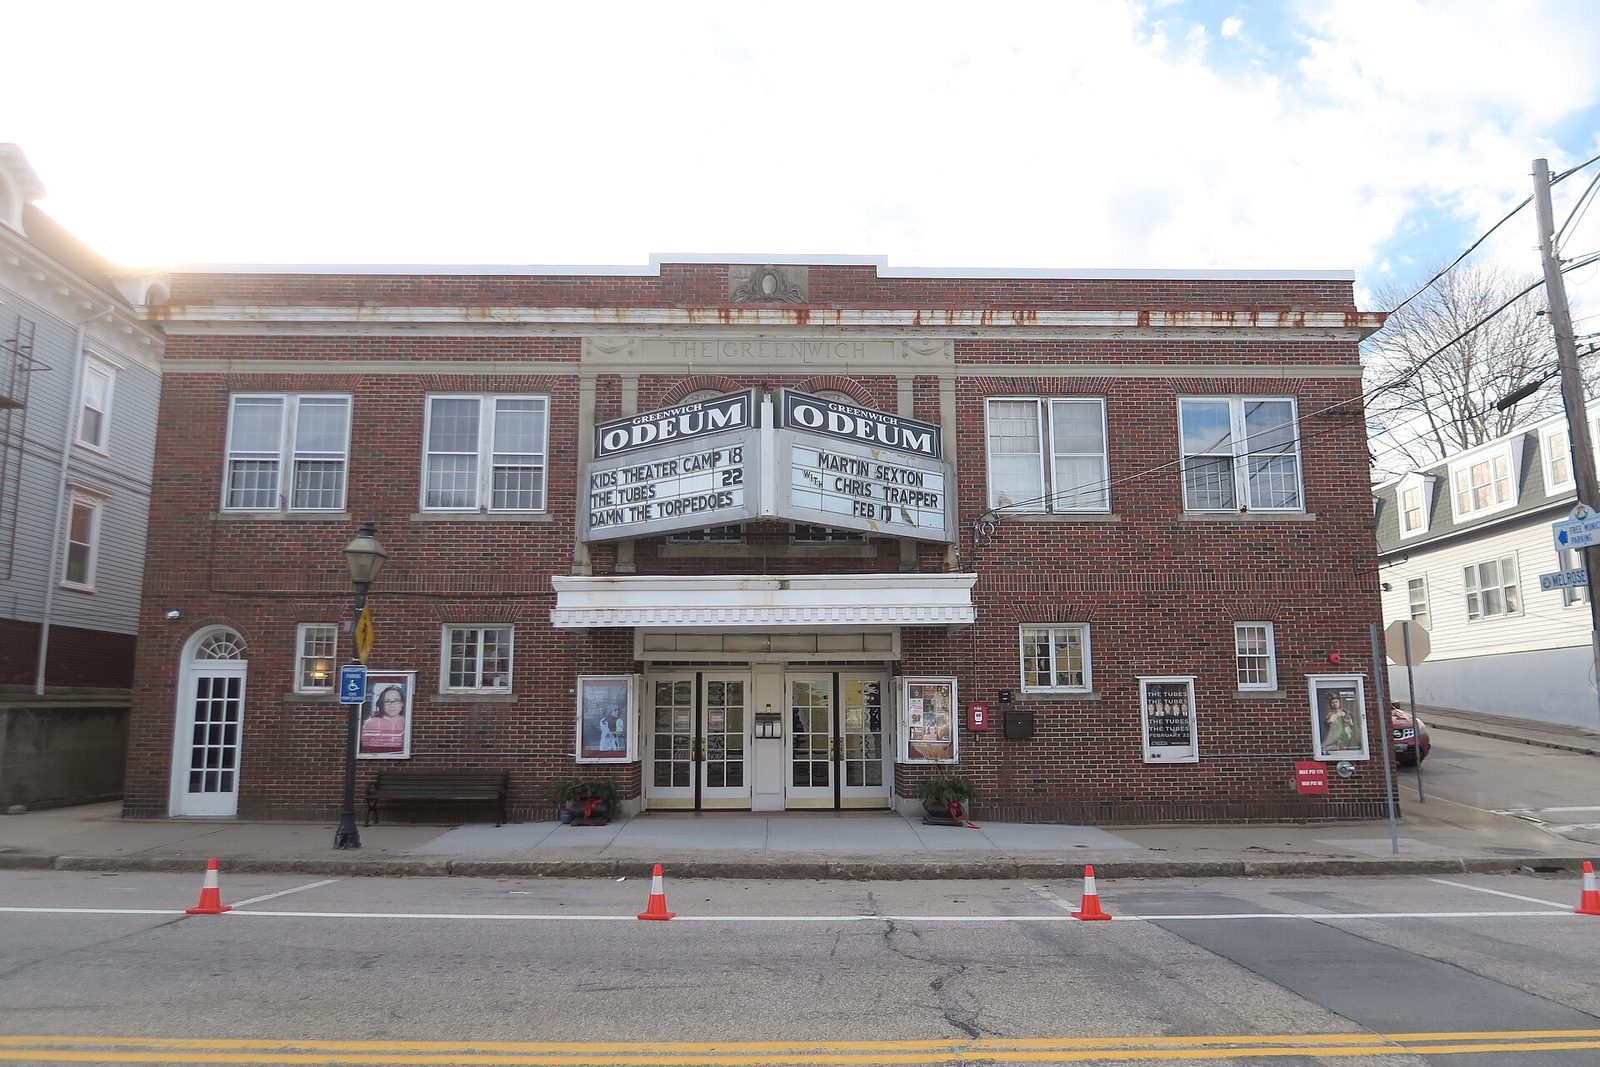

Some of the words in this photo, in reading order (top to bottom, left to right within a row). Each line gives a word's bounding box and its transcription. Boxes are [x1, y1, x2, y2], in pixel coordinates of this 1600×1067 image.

[669, 341, 713, 359] THE
[722, 342, 866, 359] GREENWICH
[603, 402, 743, 451] ODEUM
[632, 403, 703, 425] GREENWICH
[793, 404, 932, 454] ODEUM
[828, 402, 898, 426] GREENWICH
[591, 472, 618, 489] KIDS
[623, 460, 678, 482] THEATER
[683, 451, 722, 473] CAMP
[729, 447, 743, 464] 18
[818, 452, 869, 477] MARTIN
[876, 465, 924, 487] SEXTON
[591, 492, 613, 508] THE
[618, 484, 657, 504] TUBES
[722, 467, 743, 486] 22
[802, 470, 824, 488] WITH
[835, 477, 872, 497] CHRIS
[883, 486, 938, 509] TRAPPER
[590, 508, 624, 527] DAMN
[629, 505, 652, 521] THE
[657, 491, 733, 518] TORPEDOES
[853, 501, 875, 518] FEB
[881, 505, 892, 522] 17
[1551, 569, 1586, 587] MELROSE
